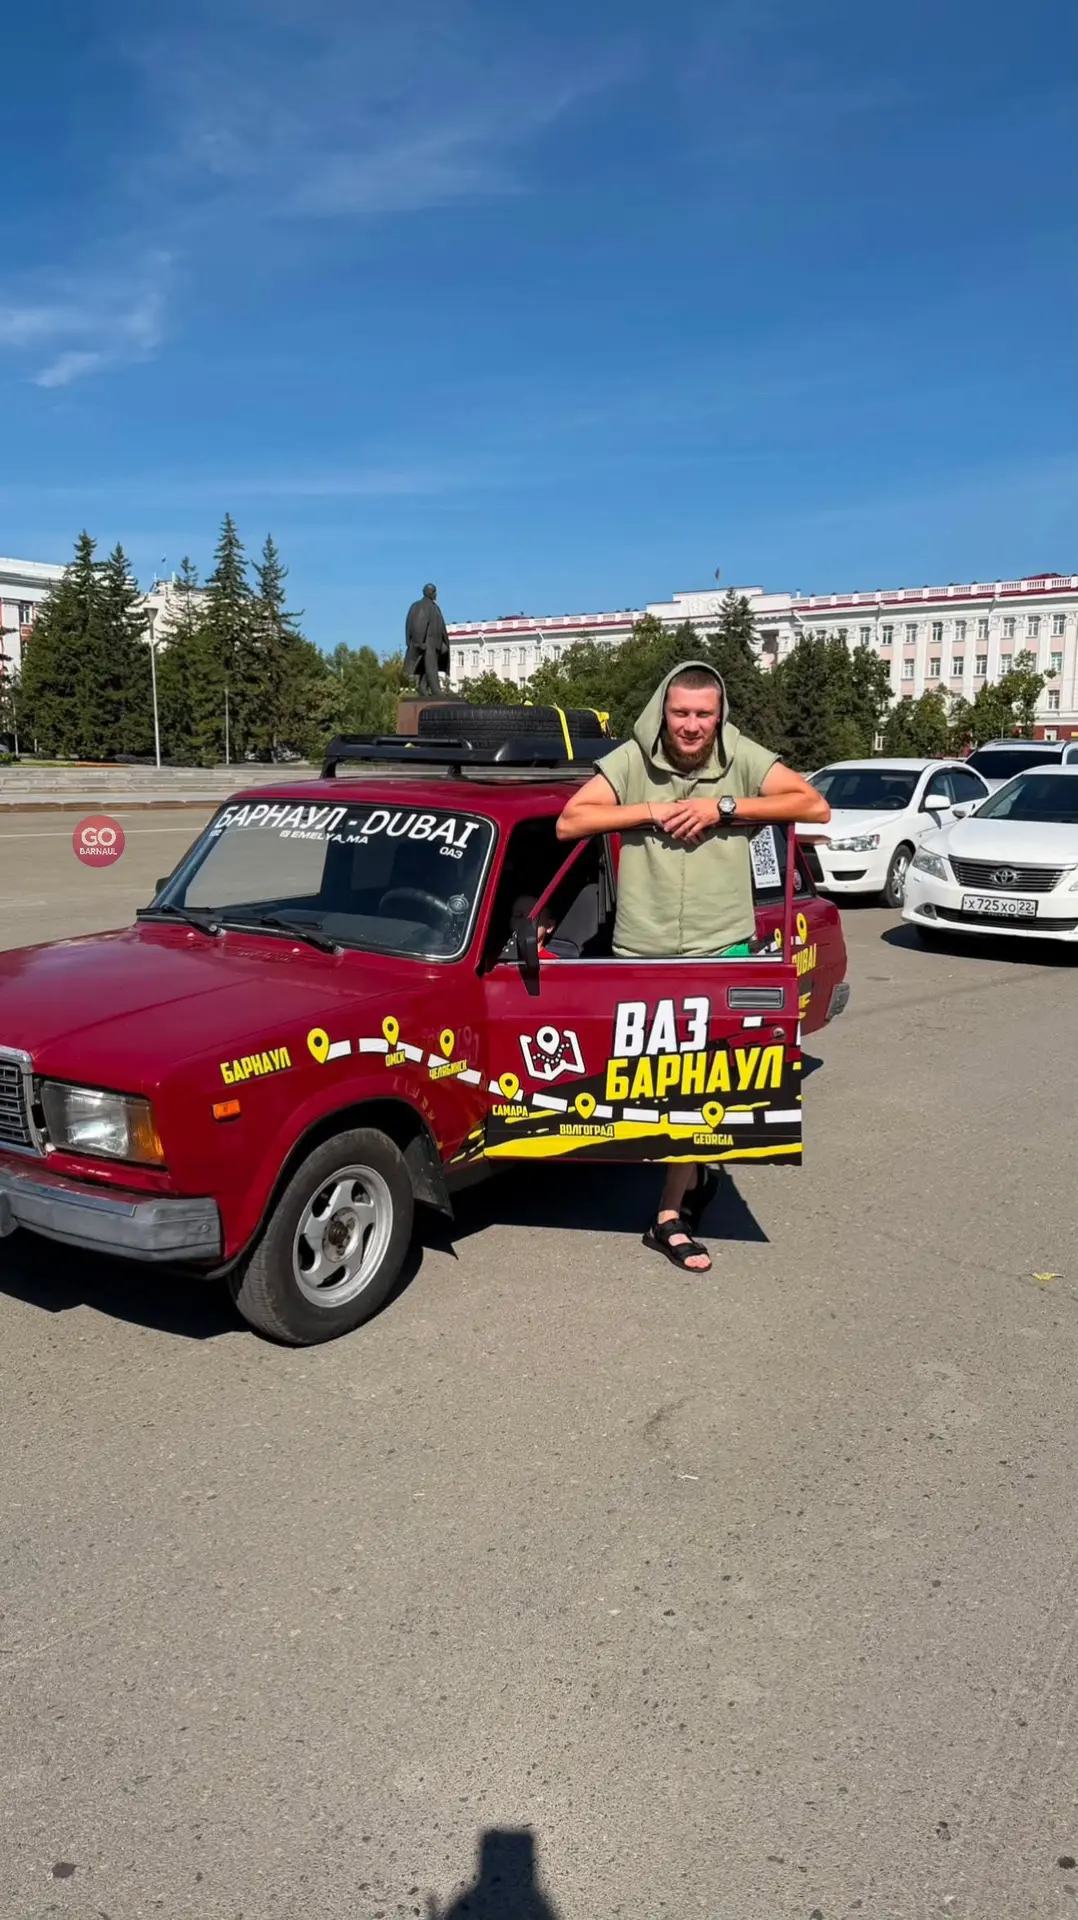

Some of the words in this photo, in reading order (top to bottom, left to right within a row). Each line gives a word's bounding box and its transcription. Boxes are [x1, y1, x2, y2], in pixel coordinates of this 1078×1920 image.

[214, 804, 348, 832] БАРНАУЛ
[360, 810, 480, 848] DUBAI
[613, 996, 710, 1058] ВАЗ
[220, 1047, 292, 1085] БАРНАУЛ
[385, 1051, 406, 1068] ОМСК
[605, 1045, 785, 1101] БАРНАУЛ
[492, 1104, 529, 1117] САМАРА
[559, 1124, 614, 1138] ВОЛГОГРАД
[693, 1132, 734, 1146] GEORGIA
